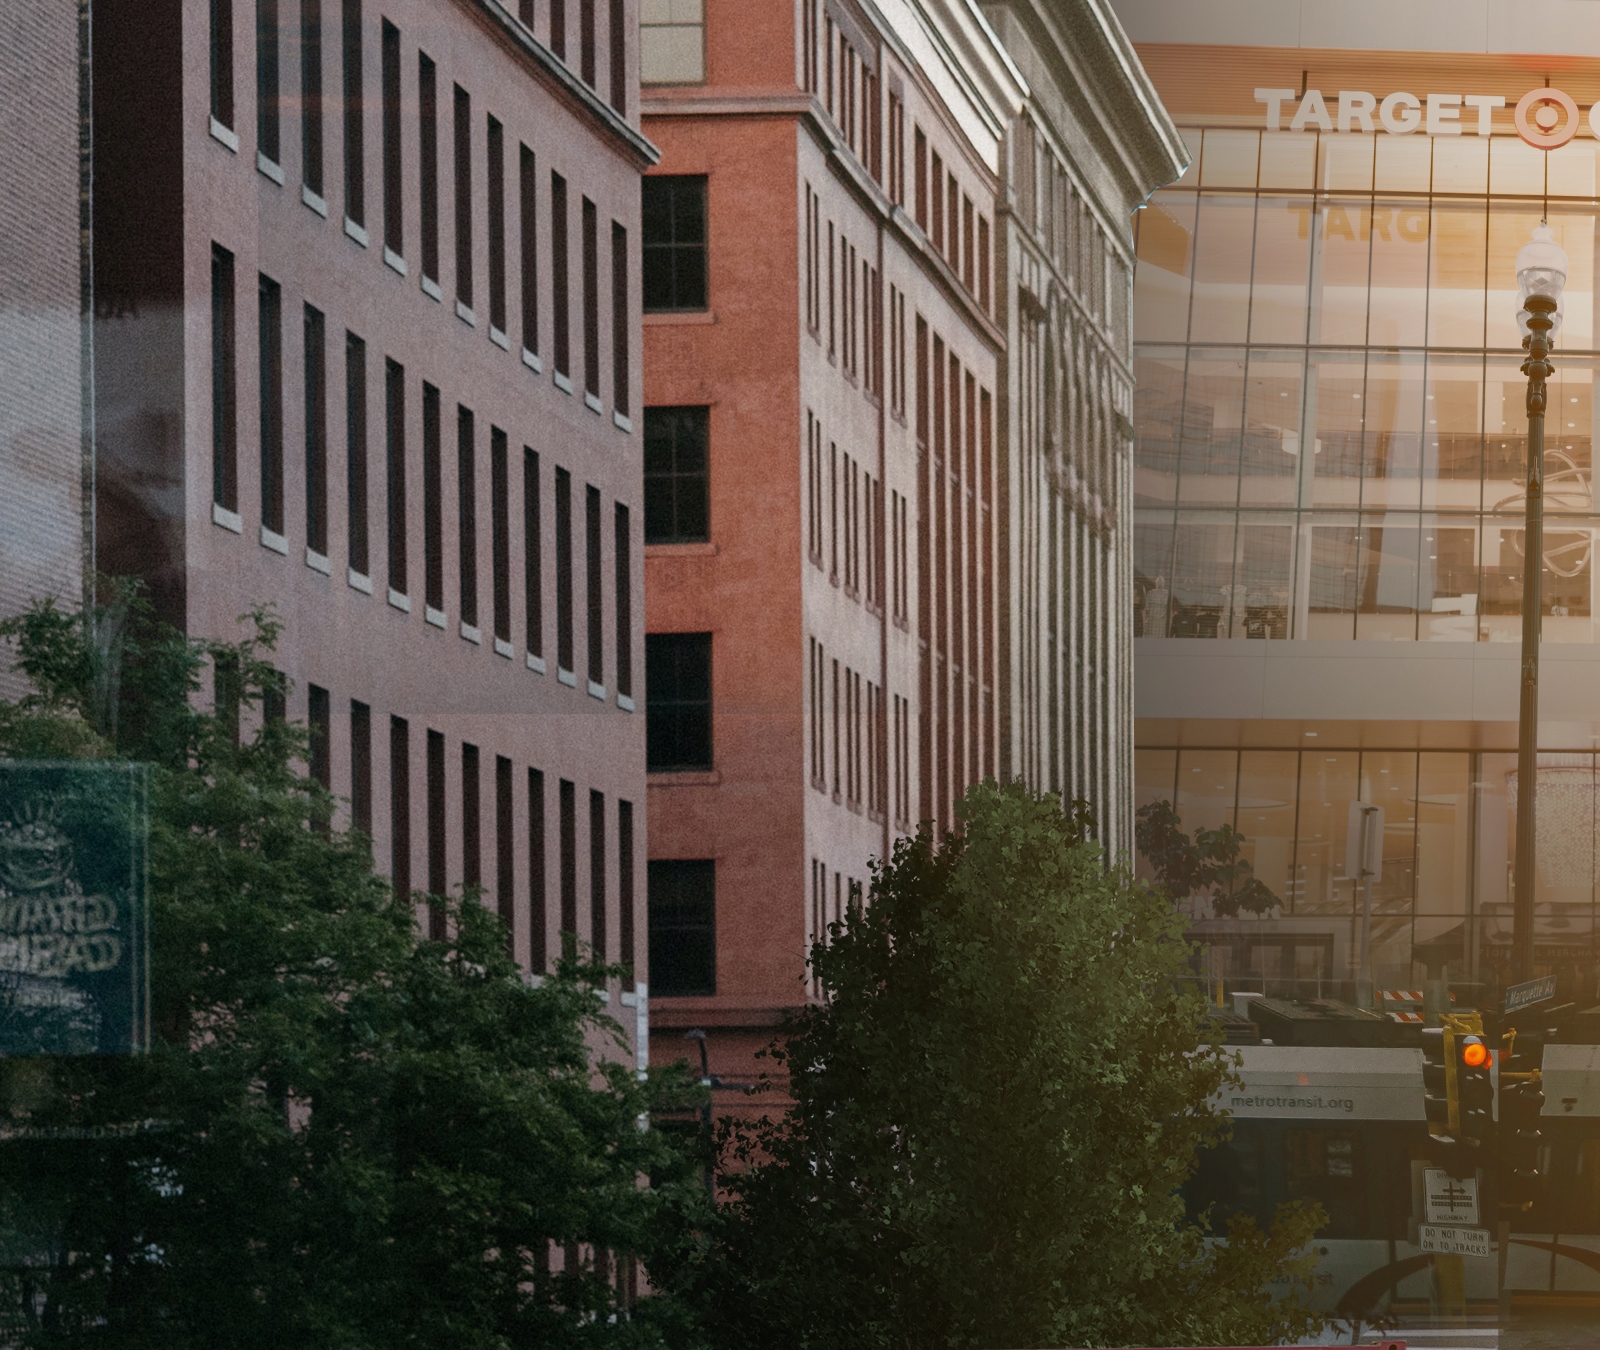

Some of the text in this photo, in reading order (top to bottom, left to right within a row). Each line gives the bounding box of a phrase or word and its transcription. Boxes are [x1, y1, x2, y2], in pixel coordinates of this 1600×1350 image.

[1254, 87, 1506, 137] TARGET
[1510, 986, 1543, 1005] Marquette
[1230, 1095, 1355, 1113] metrotransit.org
[1436, 1213, 1469, 1221] HIGHWAY
[1425, 1228, 1484, 1242] DO NOT TURN
[1422, 1240, 1487, 1255] ON TO TRACKS
